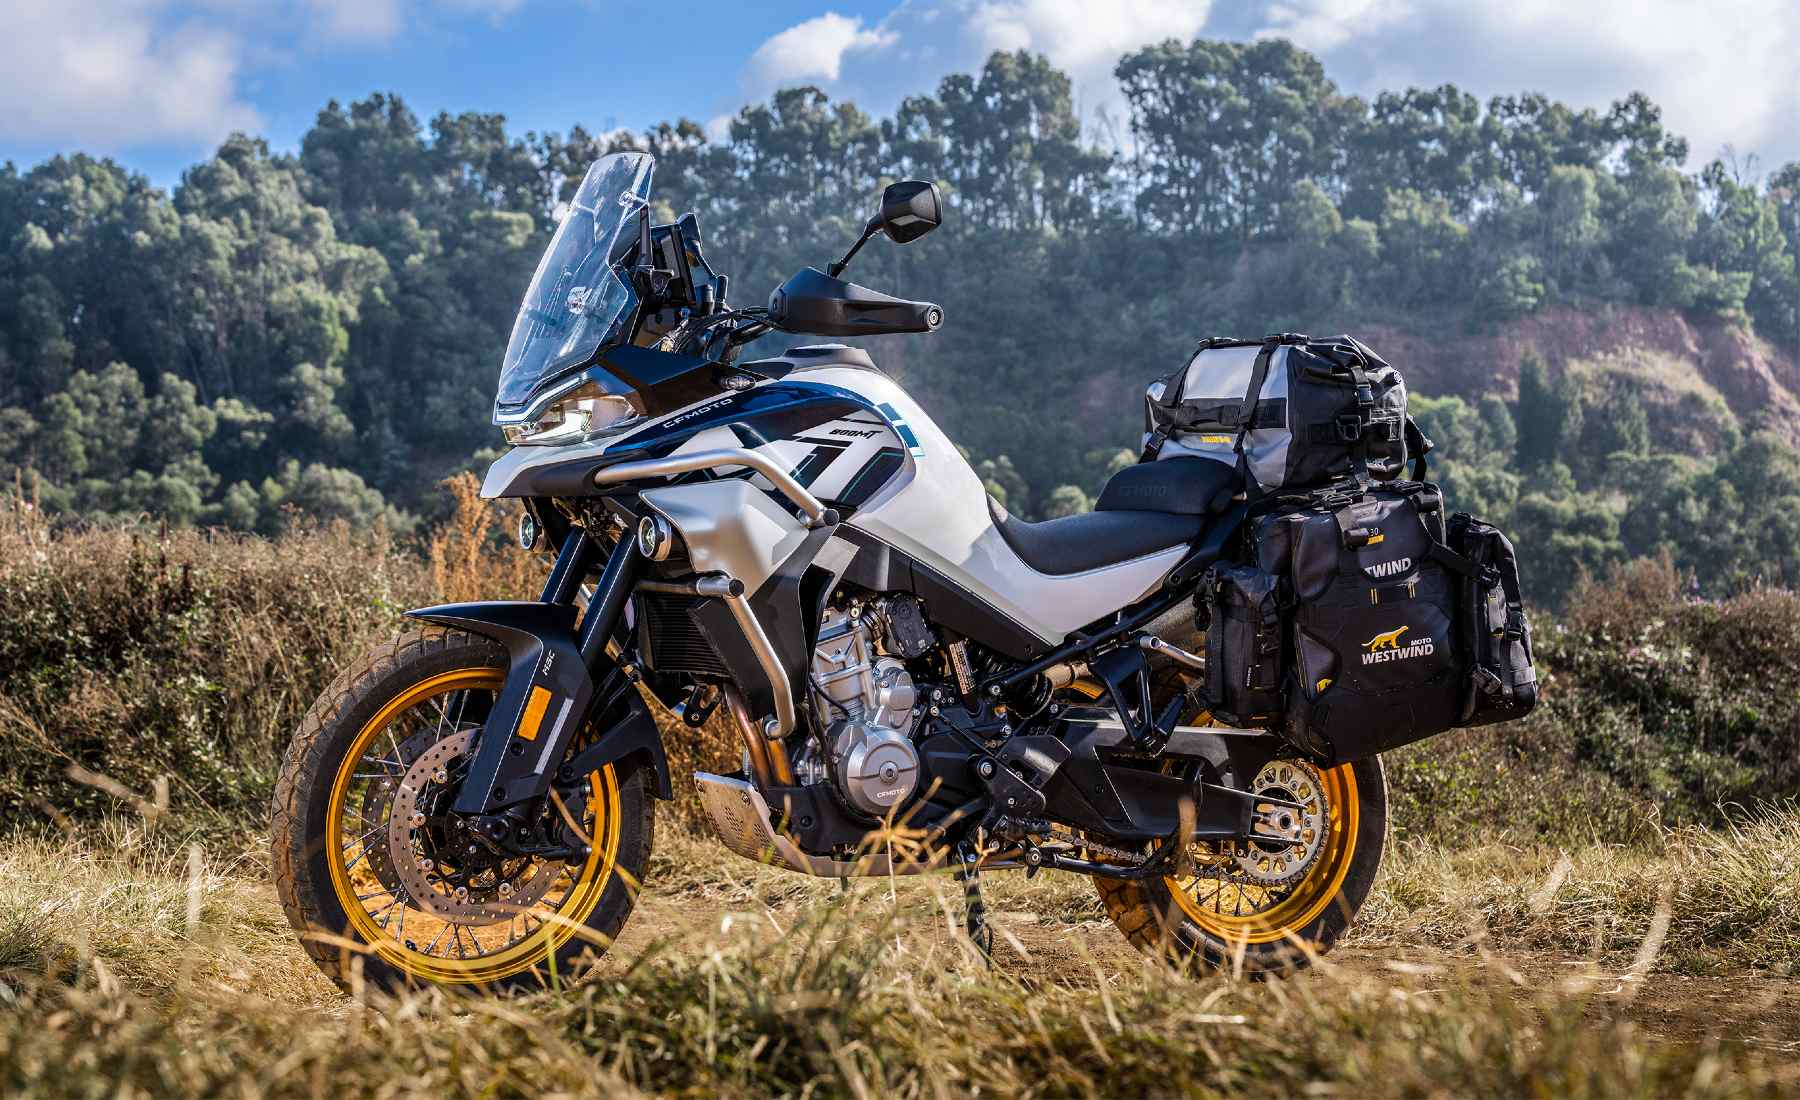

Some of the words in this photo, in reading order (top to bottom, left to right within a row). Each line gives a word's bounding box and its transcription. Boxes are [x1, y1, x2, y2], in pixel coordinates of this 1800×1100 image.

[662, 398, 733, 428] CFMOTO
[829, 429, 883, 439] 800MT
[1410, 637, 1432, 646] MOTO
[1361, 643, 1434, 665] WESTWIND
